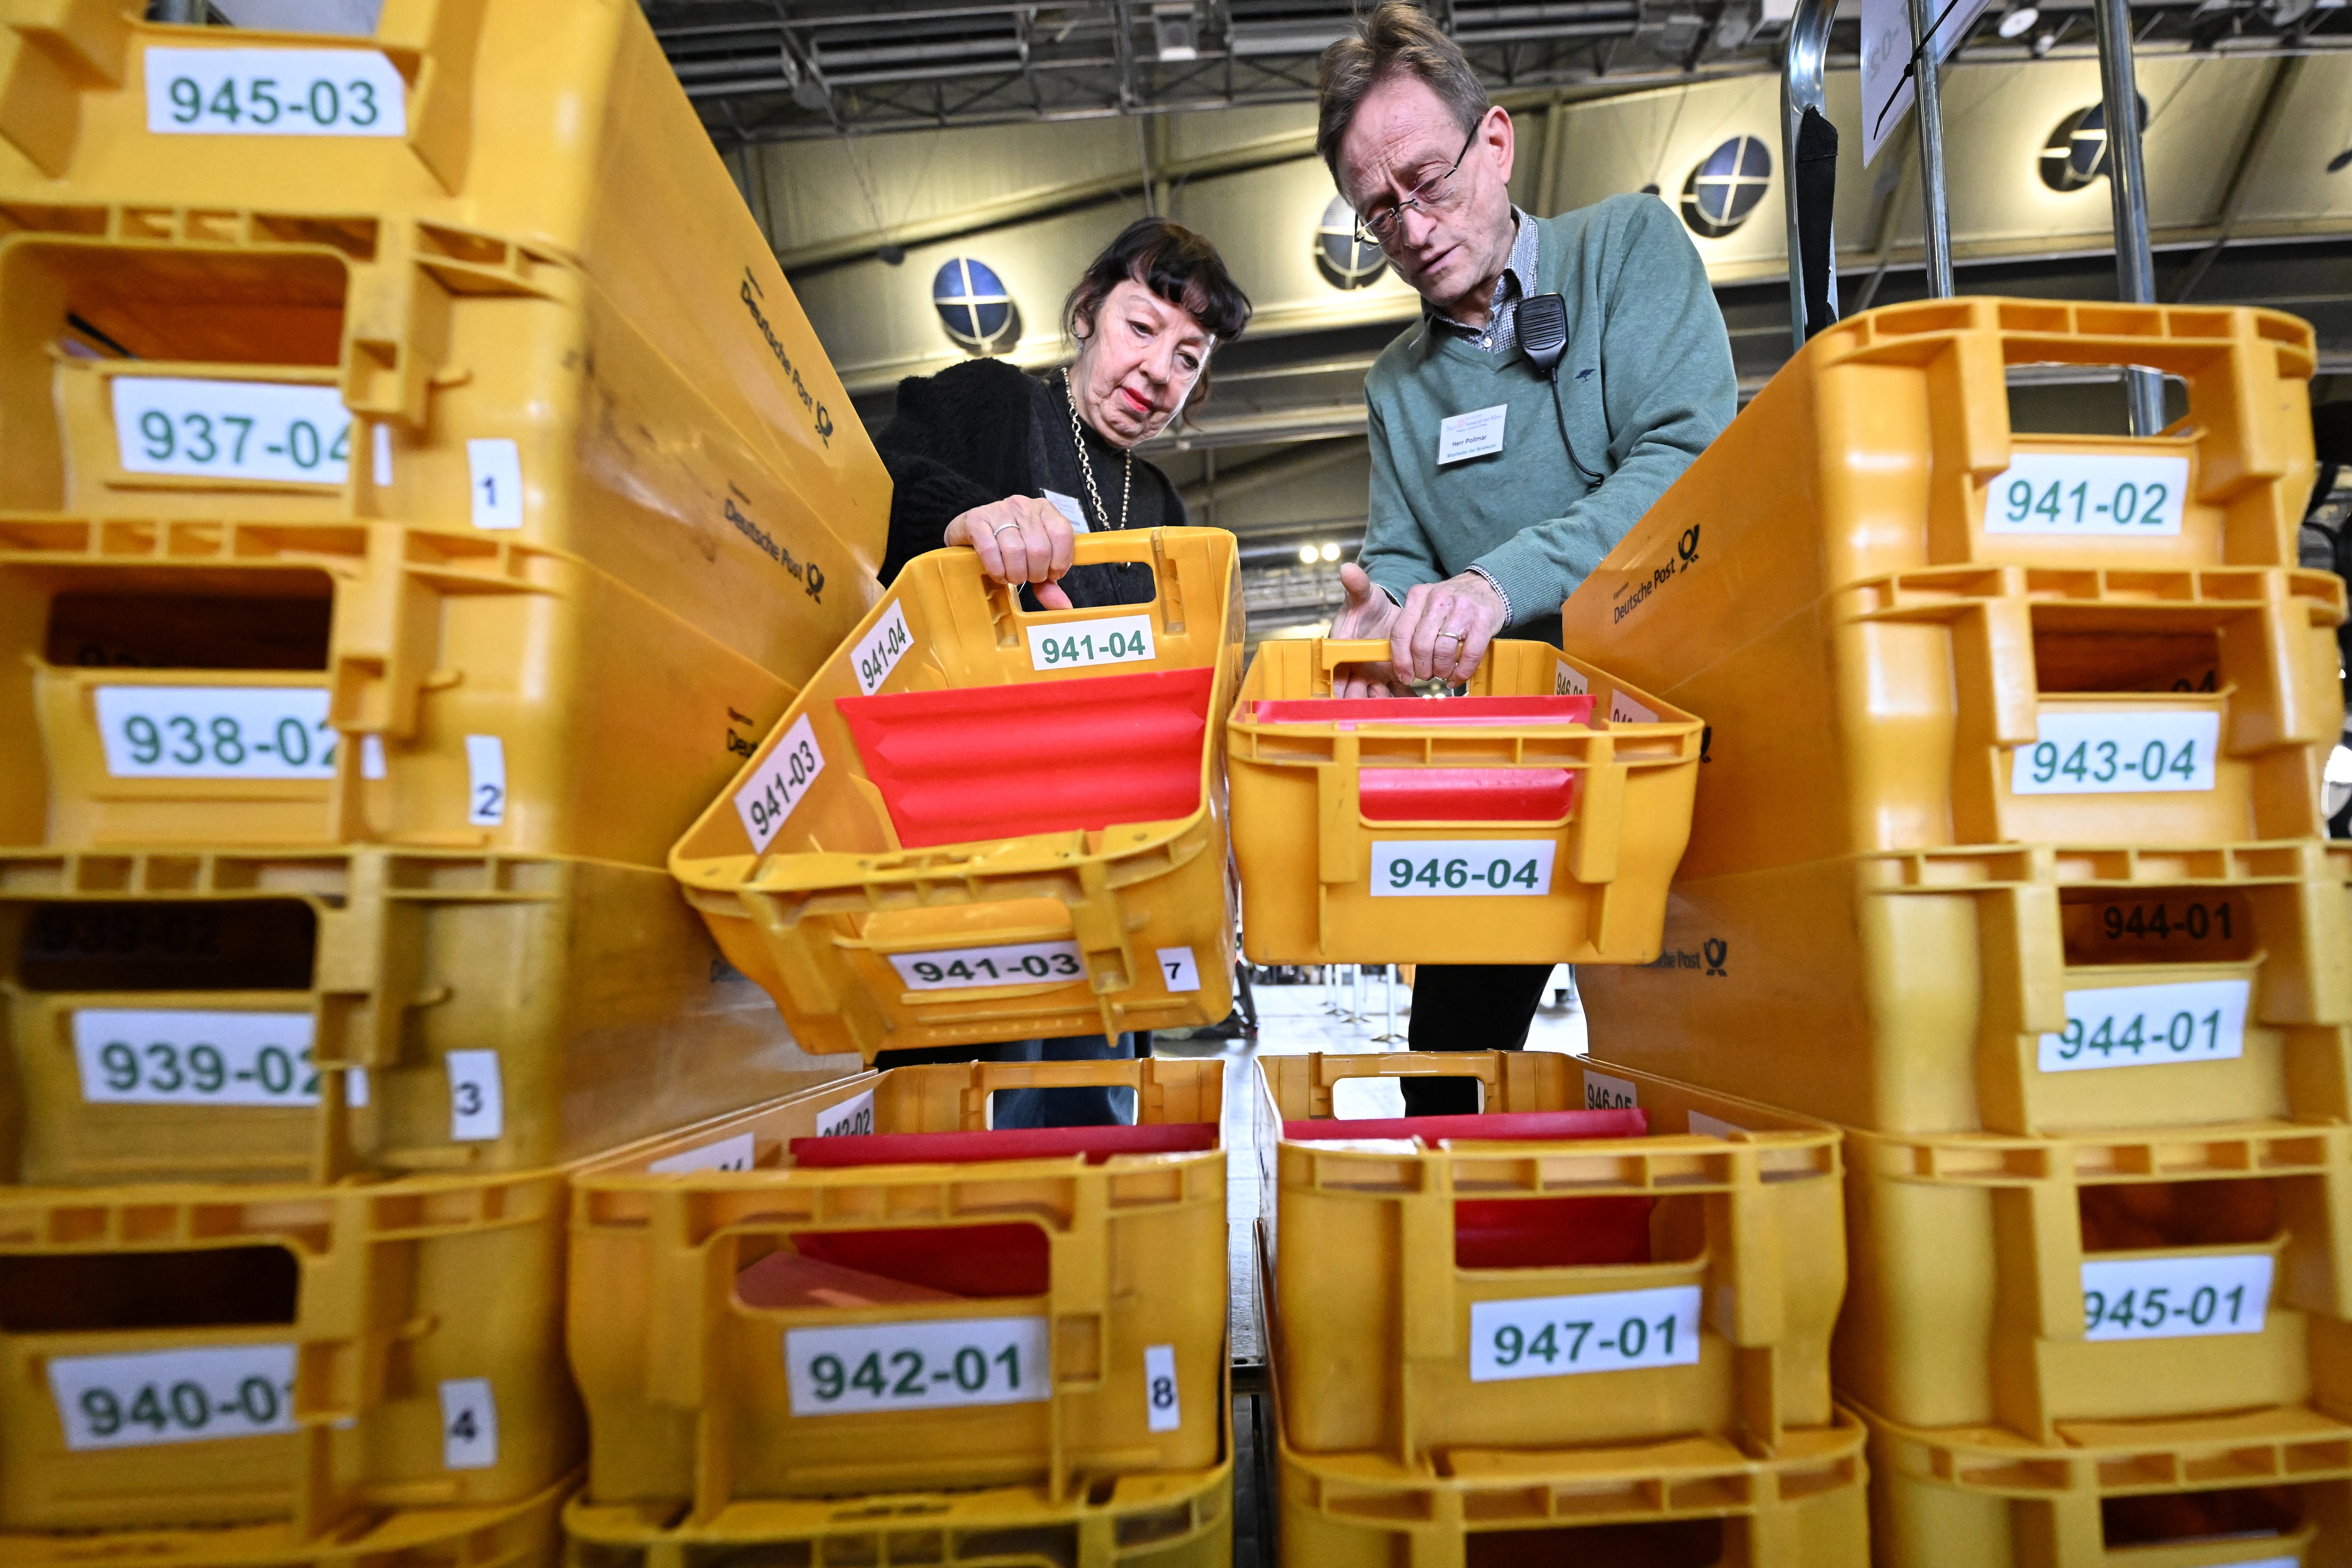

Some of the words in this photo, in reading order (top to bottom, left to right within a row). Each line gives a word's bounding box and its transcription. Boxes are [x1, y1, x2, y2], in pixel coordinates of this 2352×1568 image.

[168, 76, 380, 127] 945-03
[740, 280, 792, 376] Deutsche
[792, 368, 813, 414] Post
[480, 475, 497, 507] 1
[2006, 479, 2169, 525] 941-02
[781, 547, 803, 582] Post
[1613, 580, 1652, 625] Deutsche
[1654, 557, 1676, 589] Post
[860, 617, 907, 689] 941-04
[1041, 630, 1146, 664] 941-04
[2032, 739, 2196, 784] 943-04
[477, 784, 502, 817] 2
[750, 738, 816, 837] 941-03
[1389, 858, 1539, 889] 946-04
[2104, 902, 2232, 941] 944-01
[911, 952, 1081, 983] 941-03
[1164, 962, 1182, 980] 7
[2058, 1008, 2221, 1060] 944-01
[455, 1081, 484, 1116] 3
[2083, 1284, 2246, 1331] 945-01
[1494, 1314, 1677, 1367] 947-01
[809, 1344, 1021, 1402] 942-01
[1152, 1376, 1175, 1410] 8
[79, 1375, 294, 1438] 940-0
[448, 1408, 478, 1443] 4
